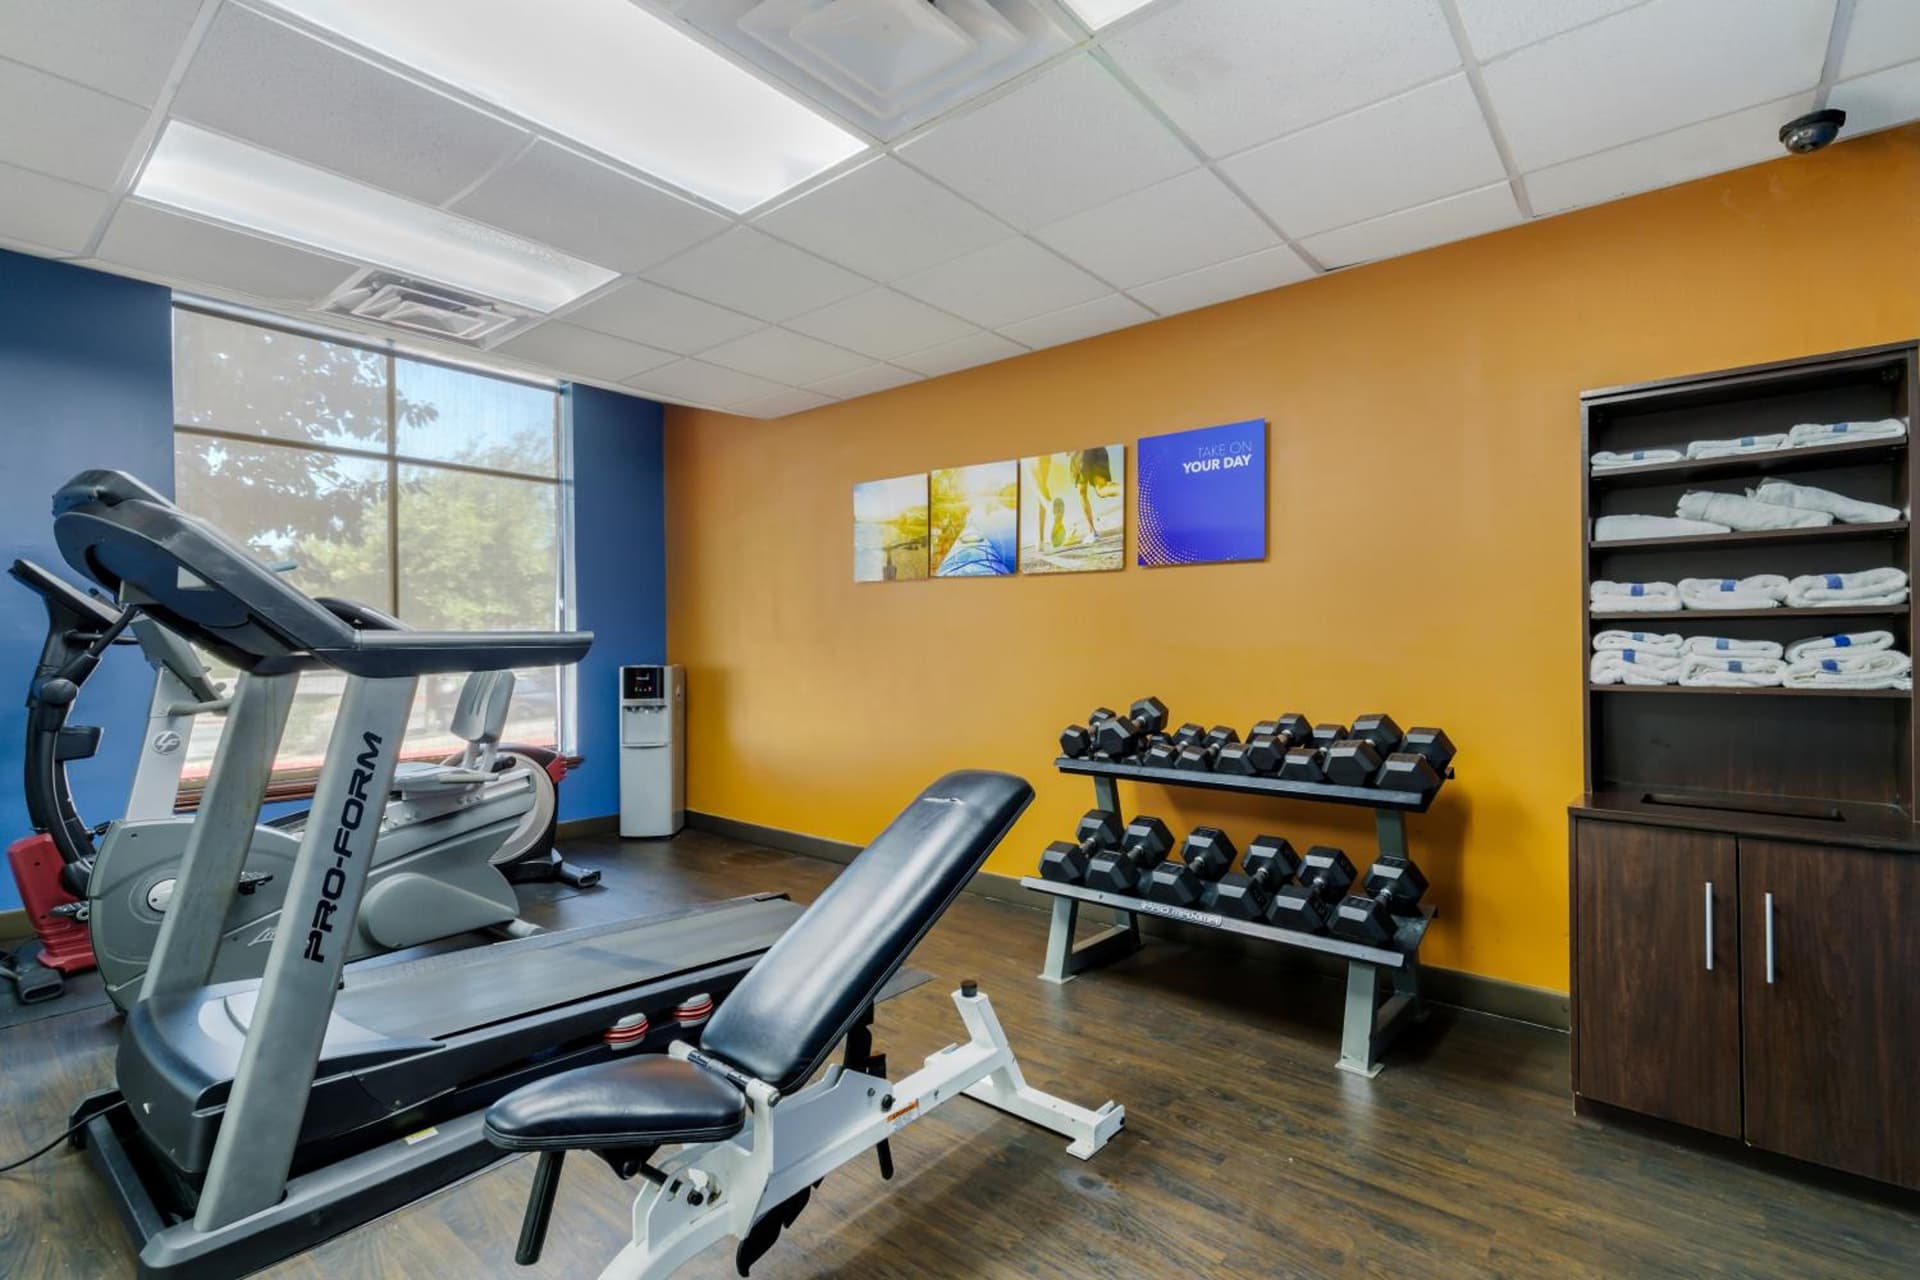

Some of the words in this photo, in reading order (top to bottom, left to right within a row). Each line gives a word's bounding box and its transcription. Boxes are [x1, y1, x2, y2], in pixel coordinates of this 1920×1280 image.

[1198, 443, 1226, 459] TAKE
[1229, 440, 1252, 454] ON
[1182, 458, 1220, 474] YOUR
[1223, 453, 1252, 469] DAY
[303, 731, 383, 963] PRO-FORM
